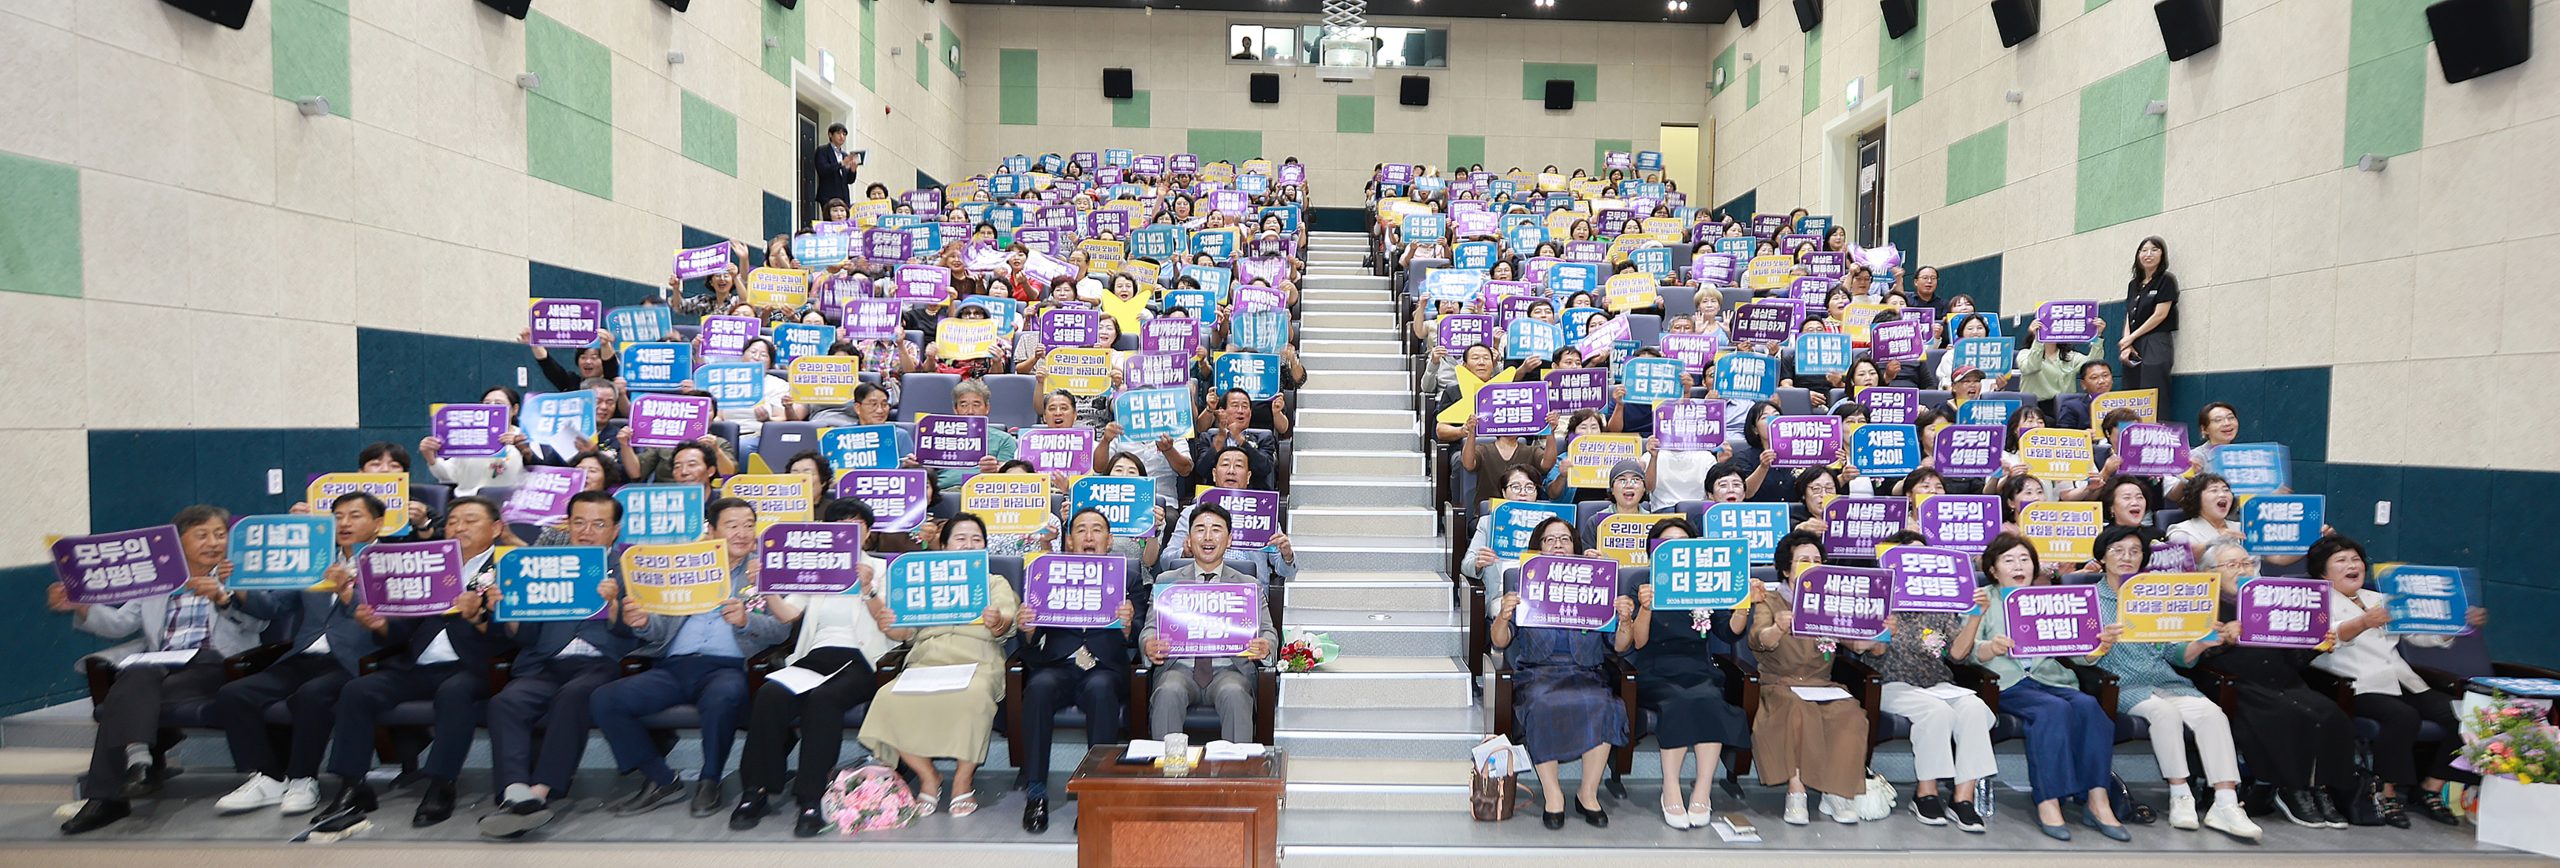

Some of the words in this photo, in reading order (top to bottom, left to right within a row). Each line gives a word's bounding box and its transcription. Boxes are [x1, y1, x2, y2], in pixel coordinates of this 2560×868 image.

[1096, 214, 1119, 223] 모두의
[1411, 218, 1418, 226] 더
[1422, 218, 1436, 226] 넓고
[1805, 220, 1825, 228] 차별은
[873, 231, 902, 244] 모두의
[1200, 235, 1223, 245] 차별은
[689, 248, 717, 260] 세상은
[1463, 245, 1488, 256] 차별은
[1812, 256, 1832, 264] 세상은
[758, 273, 779, 283] 우리의
[780, 275, 802, 284] 오늘이
[902, 269, 943, 283] 함께하는
[909, 282, 934, 295] 함평!
[548, 304, 582, 318] 세상은
[1750, 307, 1777, 320] 세상은
[2051, 304, 2086, 319] 모두의
[711, 319, 746, 334] 모두의
[1053, 313, 1086, 328] 모두의
[1451, 319, 1482, 332] 모두의
[1750, 320, 1786, 332] 평등하게
[2051, 319, 2086, 334] 성평등
[785, 328, 821, 344] 차별은
[1053, 328, 1085, 342] 성평등
[1149, 322, 1192, 336] 함께하는
[636, 349, 675, 364] 차별은
[1054, 355, 1078, 364] 우리의
[1081, 355, 1105, 364] 오늘이
[638, 366, 671, 380] 없이!
[799, 363, 822, 373] 우리의
[826, 363, 850, 373] 오늘이
[1050, 366, 1074, 375] 내일을
[1077, 367, 1108, 376] 바꿉니다
[1229, 358, 1265, 374] 차별은
[1635, 364, 1647, 377] 더
[1651, 363, 1674, 378] 넓고
[1730, 358, 1766, 375] 차별은
[794, 375, 818, 384] 내일을
[821, 375, 853, 385] 바꿉니다
[1233, 375, 1261, 390] 없이!
[1560, 373, 1590, 387] 세상은
[1635, 379, 1647, 393] 더
[1651, 378, 1674, 394] 깊게
[1733, 375, 1761, 391] 없이!
[1130, 394, 1144, 411] 더
[1147, 393, 1175, 410] 넓고
[1492, 388, 1533, 405] 모두의
[1562, 387, 1602, 401] 평등하게
[1870, 393, 1904, 408] 모두의
[642, 399, 699, 419] 함께하는
[1493, 406, 1533, 424] 성평등
[1673, 404, 1707, 419] 세상은
[1871, 408, 1904, 423] 성평등
[446, 410, 489, 427] 모두의
[1132, 413, 1146, 429] 더
[1150, 411, 1178, 428] 깊게
[651, 418, 686, 436] 함평!
[932, 421, 967, 435] 세상은
[1660, 420, 1671, 433] 더
[1675, 419, 1719, 435] 평등하게
[1779, 421, 1833, 438] 함께하는
[448, 429, 489, 446] 성평등
[837, 432, 879, 450] 차별은
[921, 437, 932, 449] 더
[935, 436, 981, 451] 평등하게
[1030, 434, 1083, 451] 함께하는
[1869, 431, 1906, 447] 차별은
[1951, 430, 1990, 447] 모두의
[2031, 436, 2057, 446] 우리의
[2060, 436, 2085, 447] 오늘이
[2130, 431, 2181, 448] 함께하는
[1791, 439, 1823, 456] 함평!
[843, 451, 876, 468] 없이!
[1040, 452, 1072, 468] 함평!
[1873, 449, 1903, 465] 없이!
[1951, 449, 1989, 465] 성평등
[2140, 448, 2174, 465] 함평!
[732, 485, 762, 496] 우리의
[767, 484, 801, 496] 오늘이
[856, 477, 905, 495] 모두의
[975, 483, 1005, 494] 우리의
[1009, 483, 1040, 494] 오늘이
[1089, 484, 1135, 502] 차별은
[628, 493, 645, 513] 더
[650, 491, 684, 512] 넓고
[762, 500, 808, 512] 바꿉니다
[969, 497, 1001, 509] 내일을
[1003, 497, 1045, 509] 바꿉니다
[1219, 496, 1257, 513] 세상은
[1721, 510, 1737, 528] 더
[1741, 509, 1772, 528] 넓고
[1847, 503, 1885, 520] 세상은
[1938, 502, 1984, 520] 모두의
[2030, 512, 2058, 523] 우리의
[2062, 511, 2093, 523] 오늘이
[2257, 502, 2304, 521] 차별은
[628, 514, 645, 535] 더
[651, 513, 685, 534] 깊게
[1611, 523, 1642, 535] 우리의
[1831, 521, 1844, 538] 더
[1939, 522, 1984, 541] 성평등
[2025, 525, 2053, 537] 내일을
[2056, 526, 2098, 538] 바꿉니다
[246, 525, 263, 546] 더
[267, 523, 310, 546] 넓고
[784, 531, 832, 549] 세상은
[2263, 524, 2300, 542] 없이!
[1604, 537, 1636, 549] 내일을
[72, 537, 150, 566] 모두의
[634, 555, 670, 567] 우리의
[675, 552, 715, 566] 오늘이
[1672, 547, 1690, 568] 더
[1695, 547, 1731, 567] 넓고
[243, 550, 261, 571] 더
[266, 549, 310, 571] 깊게
[369, 551, 445, 576] 함께하는
[520, 556, 580, 578] 차별은
[766, 551, 783, 570] 더
[787, 551, 850, 570] 평등하게
[1901, 553, 1955, 574] 모두의
[83, 560, 157, 588] 성평등
[631, 571, 664, 585] 내일을
[669, 568, 723, 585] 바꿉니다
[906, 561, 925, 583] 더
[930, 560, 967, 582] 넓고
[1048, 561, 1102, 585] 모두의
[1547, 562, 1593, 584] 세상은
[385, 577, 431, 600] 함평!
[1672, 572, 1690, 592] 더
[1695, 571, 1731, 592] 깊게
[1824, 575, 1870, 595] 세상은
[1905, 575, 1960, 598] 성평등
[527, 581, 574, 603] 없이!
[907, 587, 926, 609] 더
[931, 585, 970, 608] 깊게
[1529, 584, 1545, 602] 더
[1548, 585, 1609, 606] 평등하게
[2133, 585, 2170, 597] 우리의
[2174, 583, 2208, 597] 오늘이
[2253, 585, 2322, 609] 함께하는
[1047, 588, 1102, 611] 성평등
[1171, 590, 1247, 613] 함께하는
[1803, 593, 1820, 611] 더
[1824, 596, 1885, 620] 평등하게
[2018, 593, 2089, 616] 함께하는
[2125, 600, 2164, 614] 내일을
[2166, 600, 2213, 614] 바꿉니다
[2268, 610, 2311, 632] 함평!
[2036, 618, 2078, 641] 함평!
